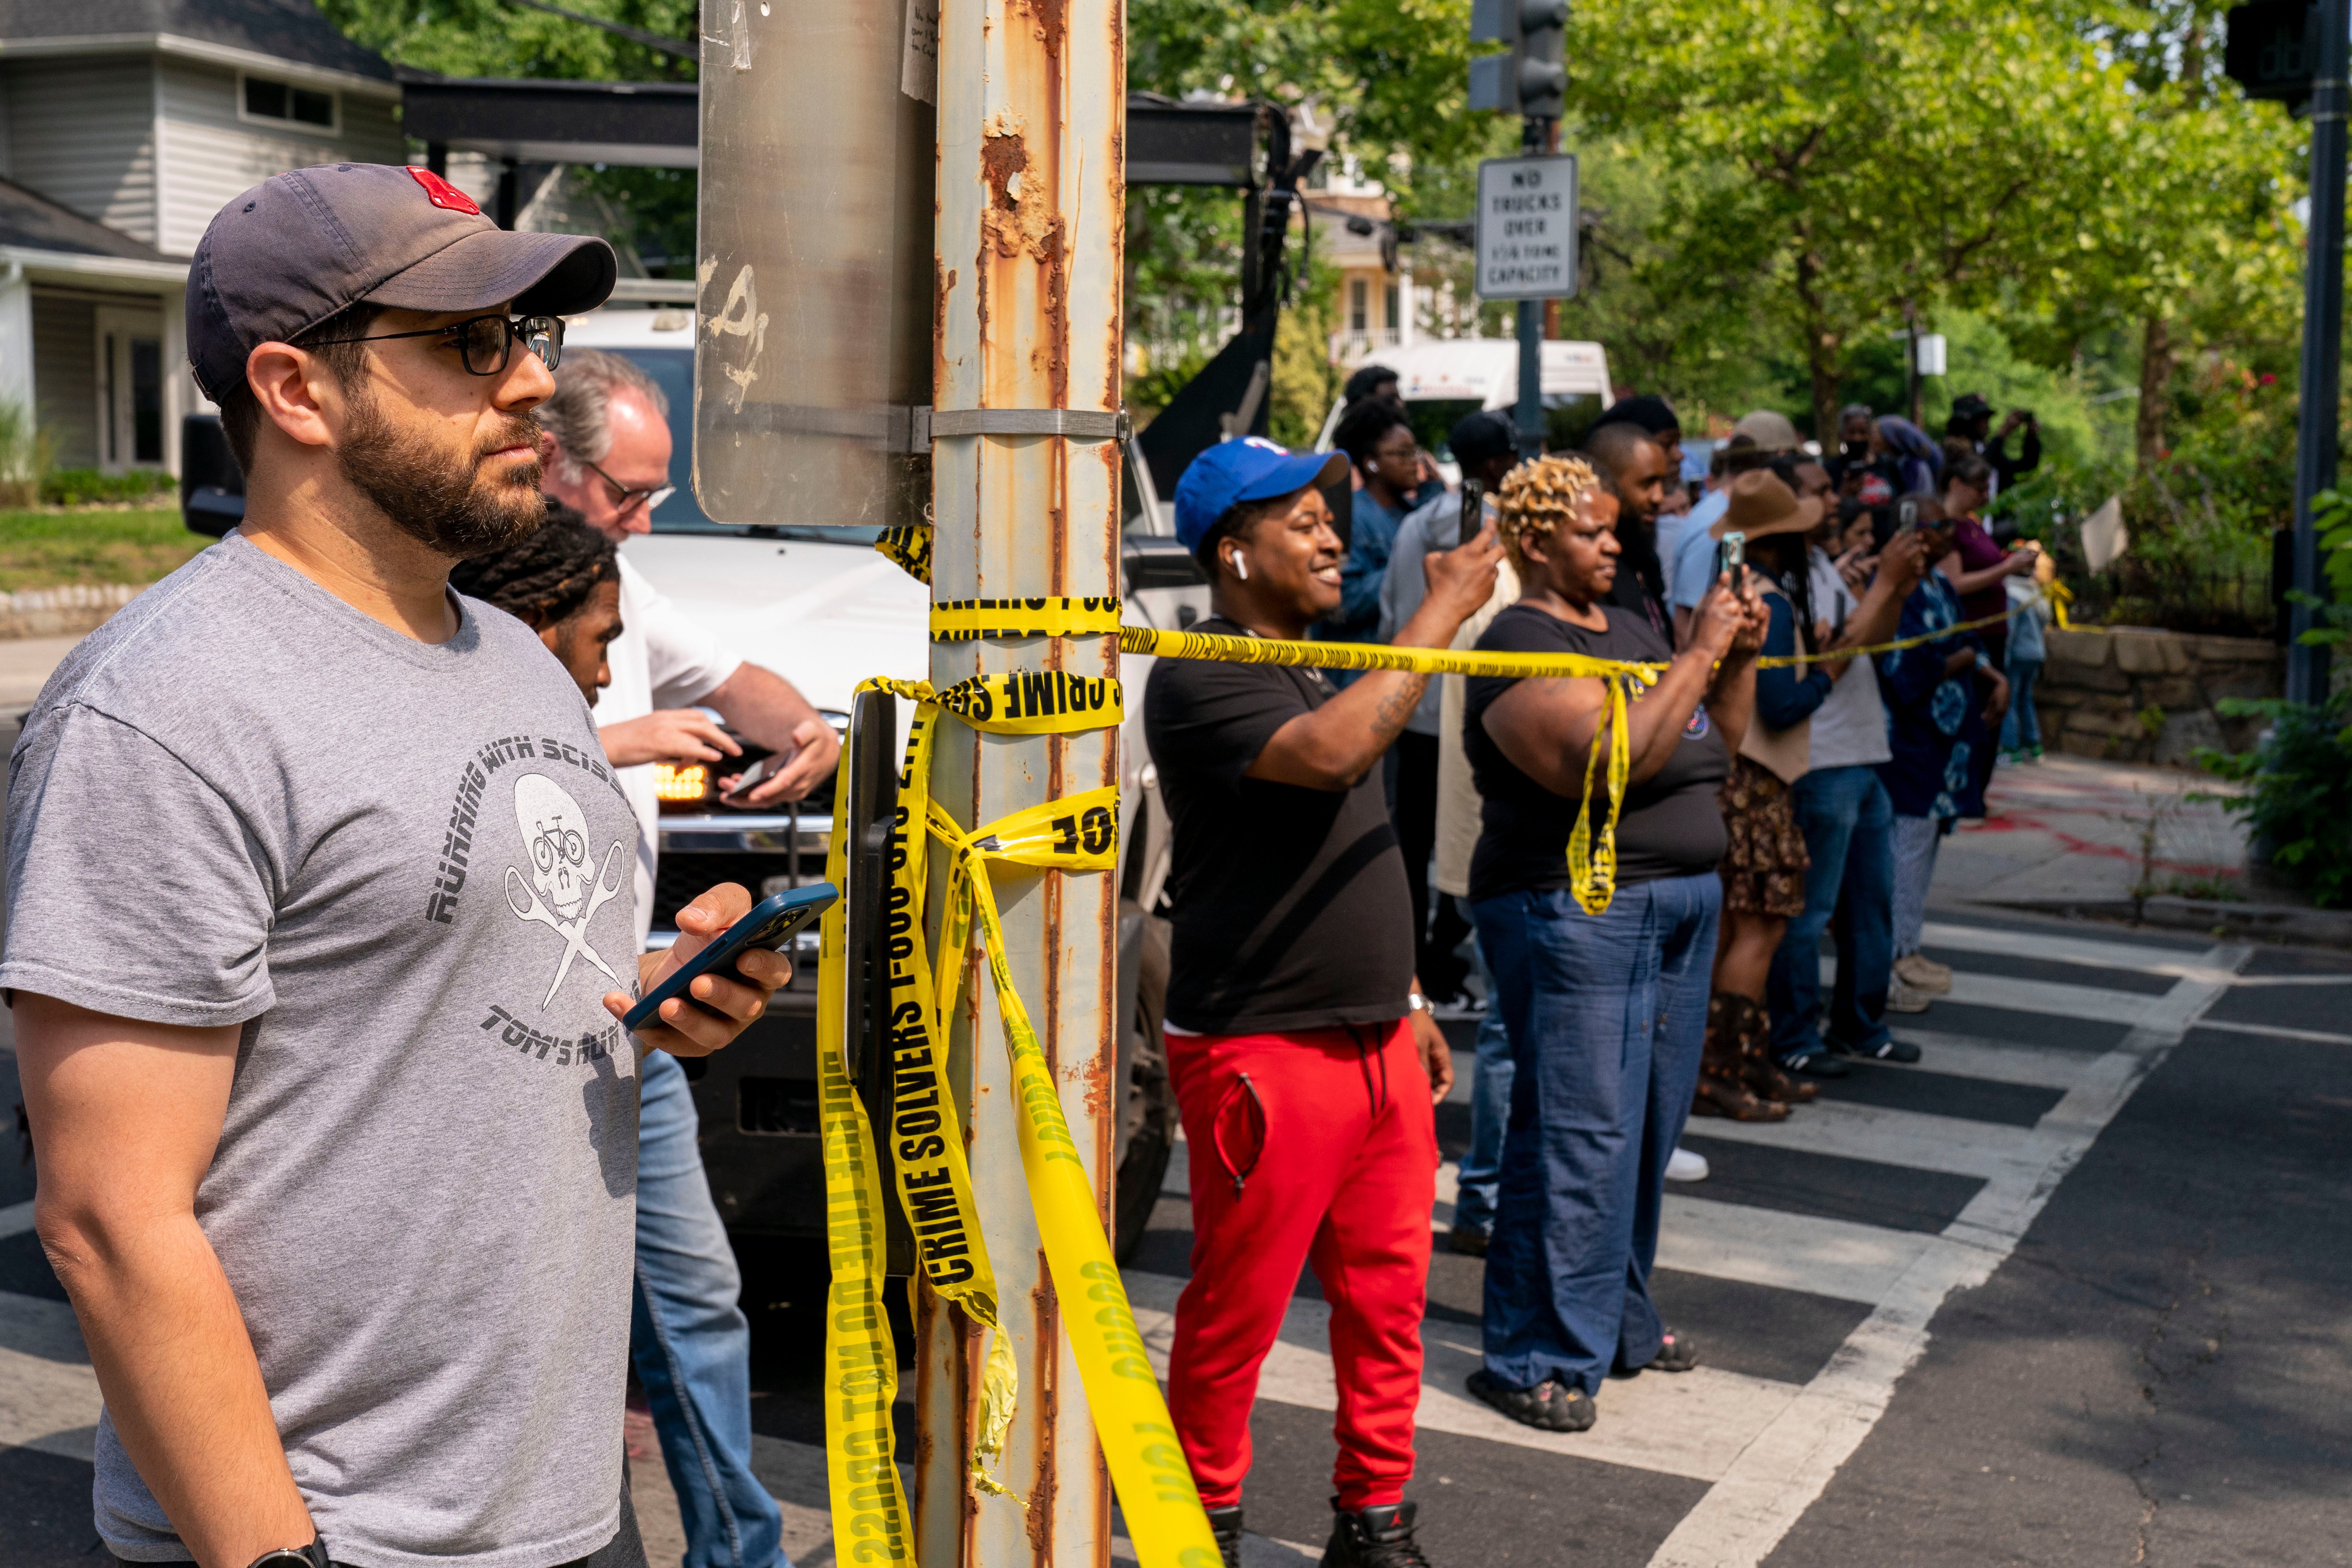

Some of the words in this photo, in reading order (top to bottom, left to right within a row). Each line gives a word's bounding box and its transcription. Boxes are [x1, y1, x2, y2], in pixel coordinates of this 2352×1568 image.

[1493, 192, 1561, 214] TRUCKS
[1512, 169, 1542, 189] NO
[1504, 217, 1546, 237] OVER
[1488, 265, 1561, 285] CAPACITY
[1004, 671, 1105, 719] CRIME
[425, 760, 486, 924] RUNNING
[477, 736, 535, 775] WITH
[480, 1005, 572, 1065] TOM'S
[892, 1000, 945, 1162] SOLVERS
[904, 1166, 974, 1287] CRIME
